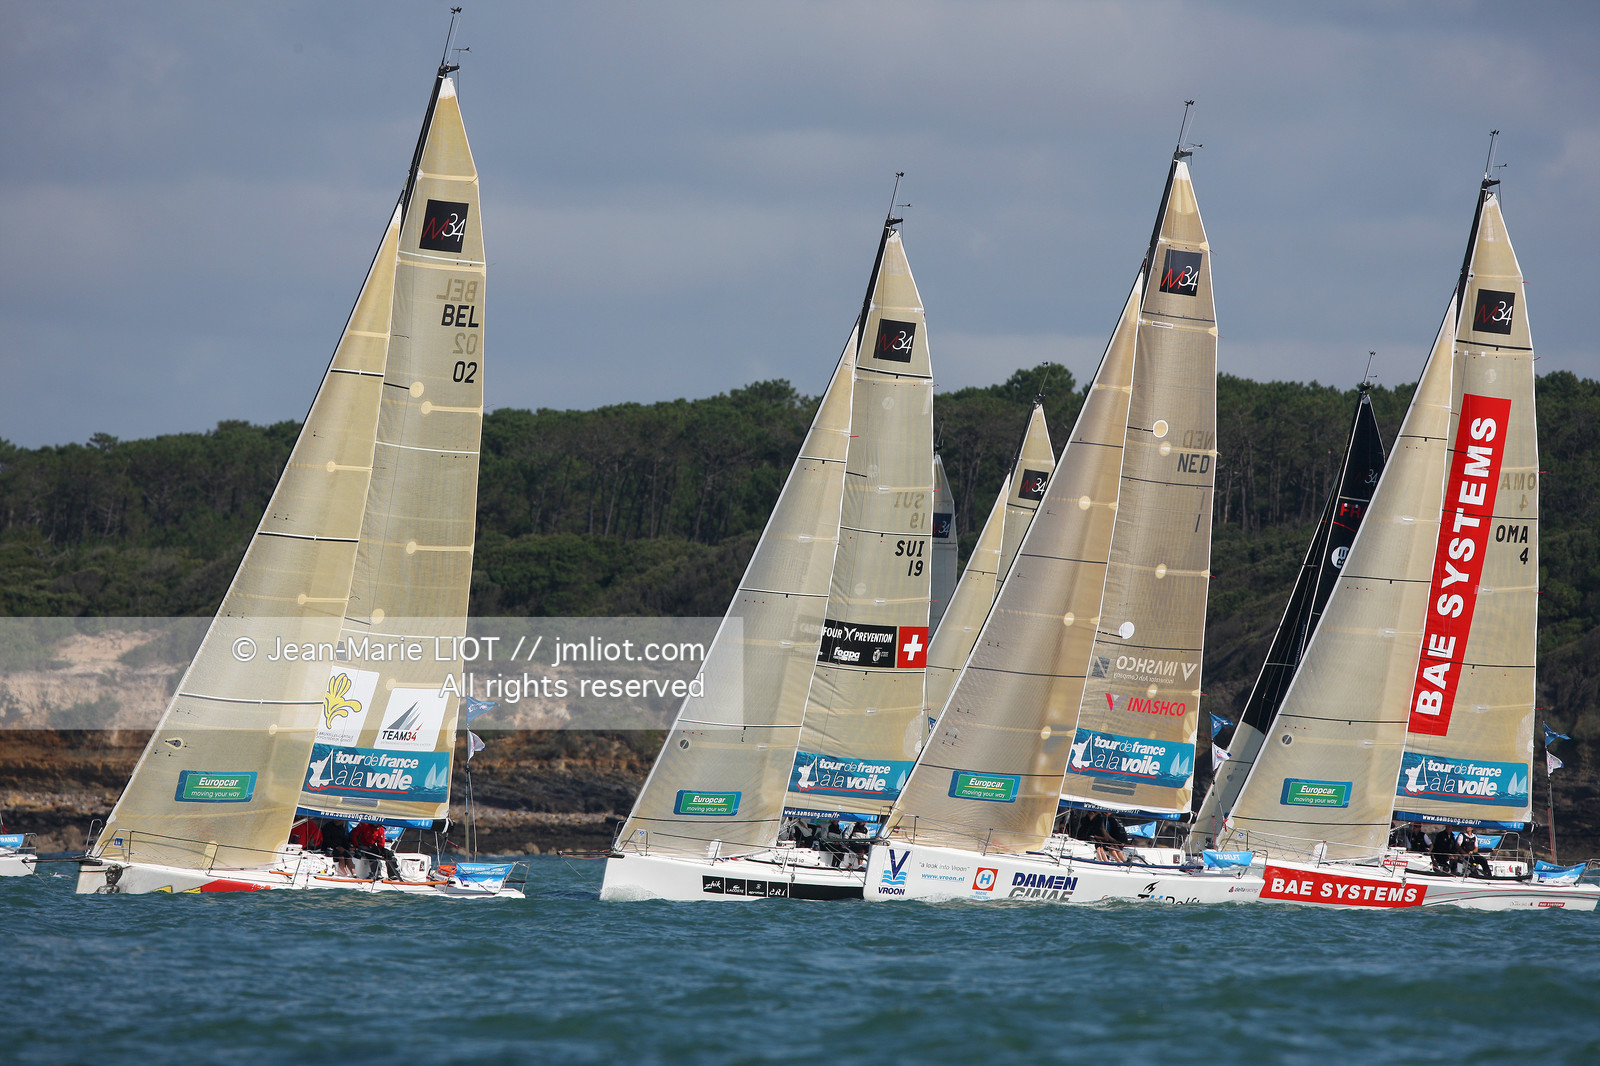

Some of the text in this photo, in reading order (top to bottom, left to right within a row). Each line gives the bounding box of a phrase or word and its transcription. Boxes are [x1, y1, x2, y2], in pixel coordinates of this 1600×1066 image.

[423, 213, 466, 242] M34
[1161, 265, 1200, 291] M34
[441, 304, 479, 328] BEL
[1474, 301, 1513, 327] M34
[876, 330, 914, 354] M34
[453, 360, 477, 383] 02
[1177, 453, 1210, 474] NED
[1021, 477, 1048, 495] M34
[1496, 524, 1528, 544] OMA
[895, 540, 925, 557] SUI
[1519, 547, 1529, 565] 4
[908, 560, 923, 576] 19
[1415, 417, 1498, 717] BAE SYSTEMS
[822, 626, 843, 639] FOUR
[854, 631, 893, 644] PREVENTION
[1127, 697, 1186, 717] INASHCO
[1106, 751, 1120, 770] la
[1121, 755, 1160, 775] voile
[199, 777, 239, 789] Europcar
[348, 766, 365, 787] la
[366, 769, 413, 790] voile
[831, 771, 844, 788] la
[846, 774, 886, 791] voile
[968, 778, 1004, 789] Europcar
[1442, 774, 1456, 793] la
[1457, 777, 1497, 796] voile
[692, 795, 726, 804] Europcar
[962, 789, 982, 797] moving
[1300, 785, 1336, 796] Europcar
[783, 808, 841, 819] www.samsung.com/fr
[921, 873, 965, 882] www.vroon.nl
[979, 873, 992, 885] H
[1012, 872, 1079, 891] DAMEN
[878, 887, 906, 896] VROON
[1270, 878, 1418, 902] BAE SYSTEMS
